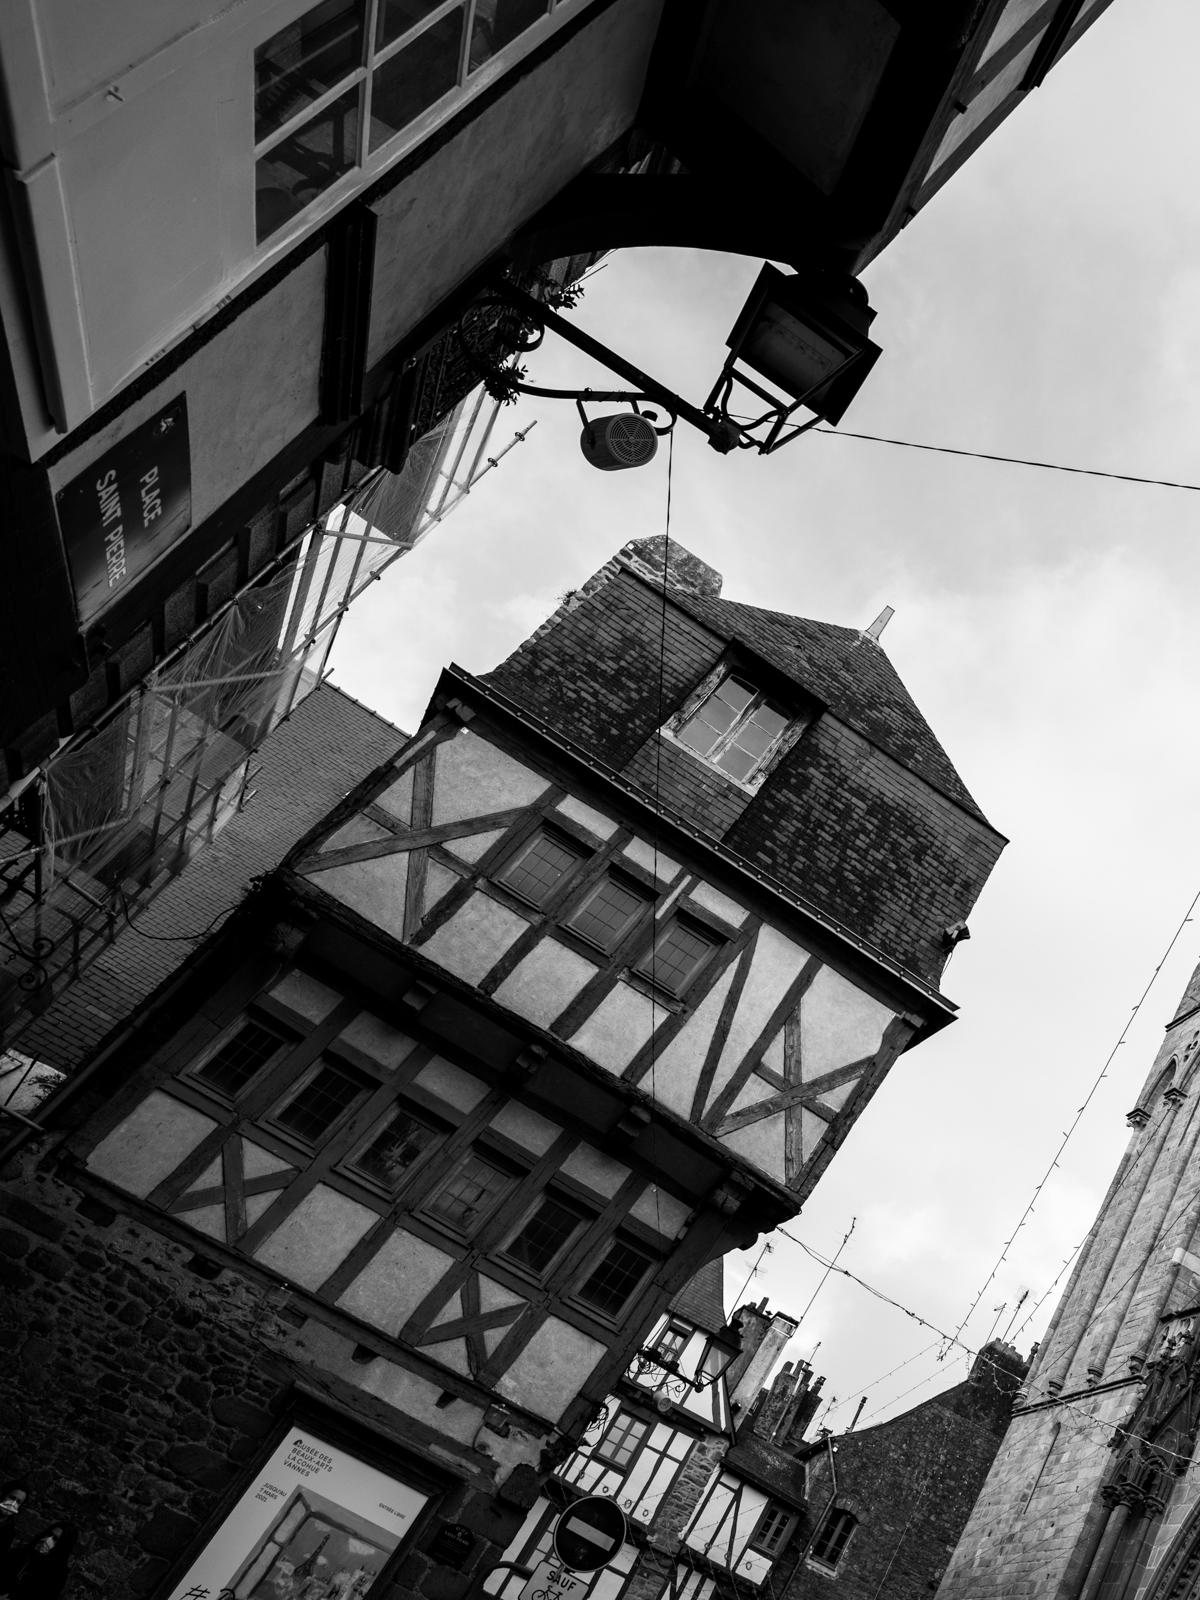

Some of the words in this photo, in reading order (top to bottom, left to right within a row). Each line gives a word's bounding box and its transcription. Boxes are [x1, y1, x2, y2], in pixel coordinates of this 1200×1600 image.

[96, 470, 122, 527] SAINT
[140, 466, 162, 528] PLACE
[104, 524, 127, 587] PIERRE
[283, 1459, 310, 1477] VANNES
[287, 1453, 297, 1462] LA
[296, 1458, 320, 1474] COHUE
[291, 1447, 333, 1472] BEAUX-ARTS
[318, 1453, 332, 1464] DES
[546, 1570, 577, 1591] SAUF
